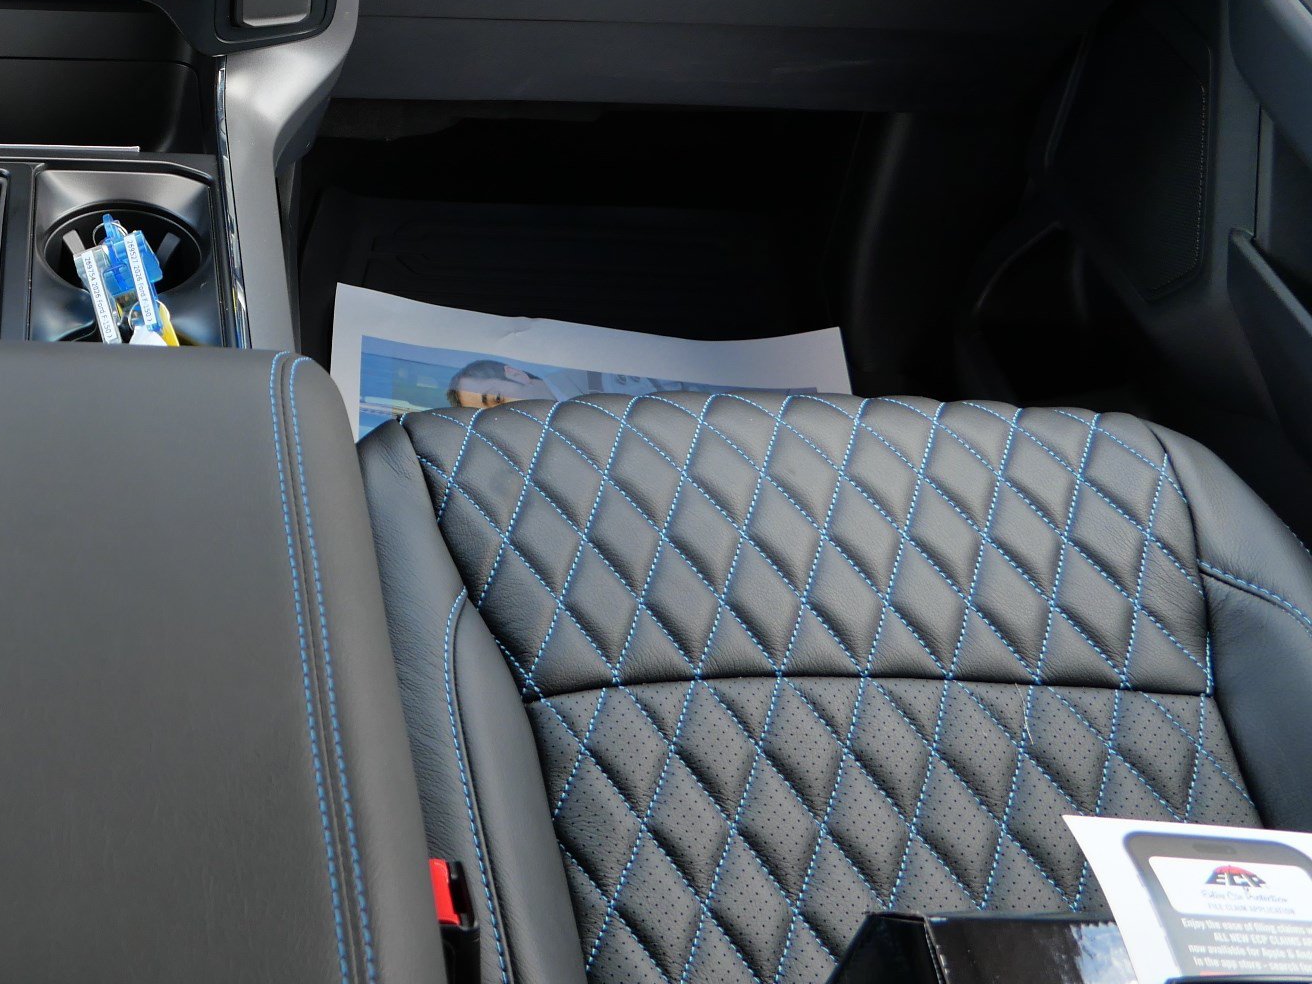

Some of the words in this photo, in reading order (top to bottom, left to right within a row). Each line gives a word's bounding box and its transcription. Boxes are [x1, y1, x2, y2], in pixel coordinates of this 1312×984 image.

[133, 265, 143, 282] 2026
[138, 282, 146, 298] Ford
[91, 283, 100, 298] 2026
[1181, 918, 1205, 930] Enjoy
[1205, 919, 1221, 929] the
[1213, 932, 1229, 942] ALL
[1229, 932, 1249, 943] NEW
[1269, 935, 1302, 946] CLAIMS
[1188, 944, 1206, 953] now
[1207, 944, 1246, 956] available
[1203, 956, 1220, 967] the
